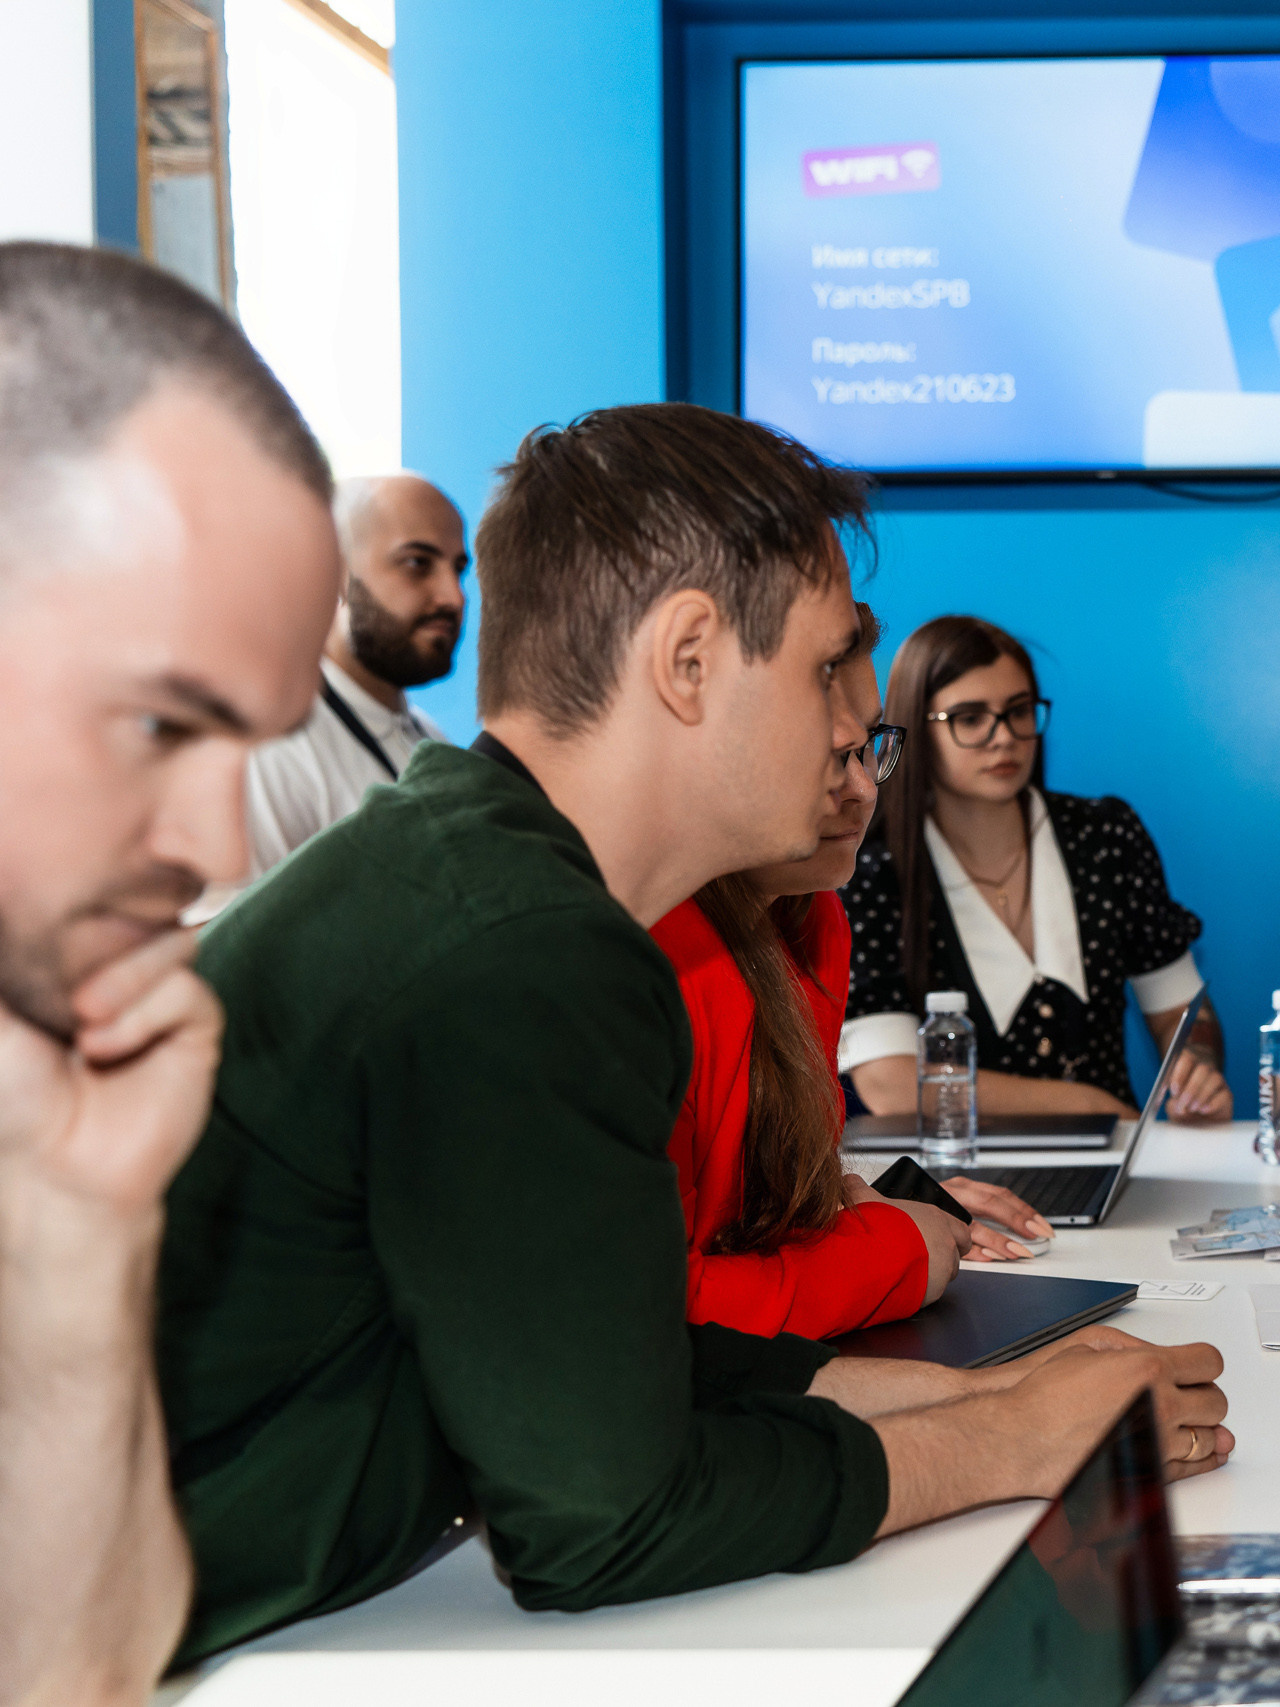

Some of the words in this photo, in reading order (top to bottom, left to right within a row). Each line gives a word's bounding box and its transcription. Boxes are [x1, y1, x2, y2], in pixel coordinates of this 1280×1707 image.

[812, 244, 868, 269] Имя
[872, 246, 940, 269] сети:
[811, 279, 970, 308] YandexSPB
[811, 338, 916, 366] Пароль:
[811, 373, 1016, 403] Yandex210623
